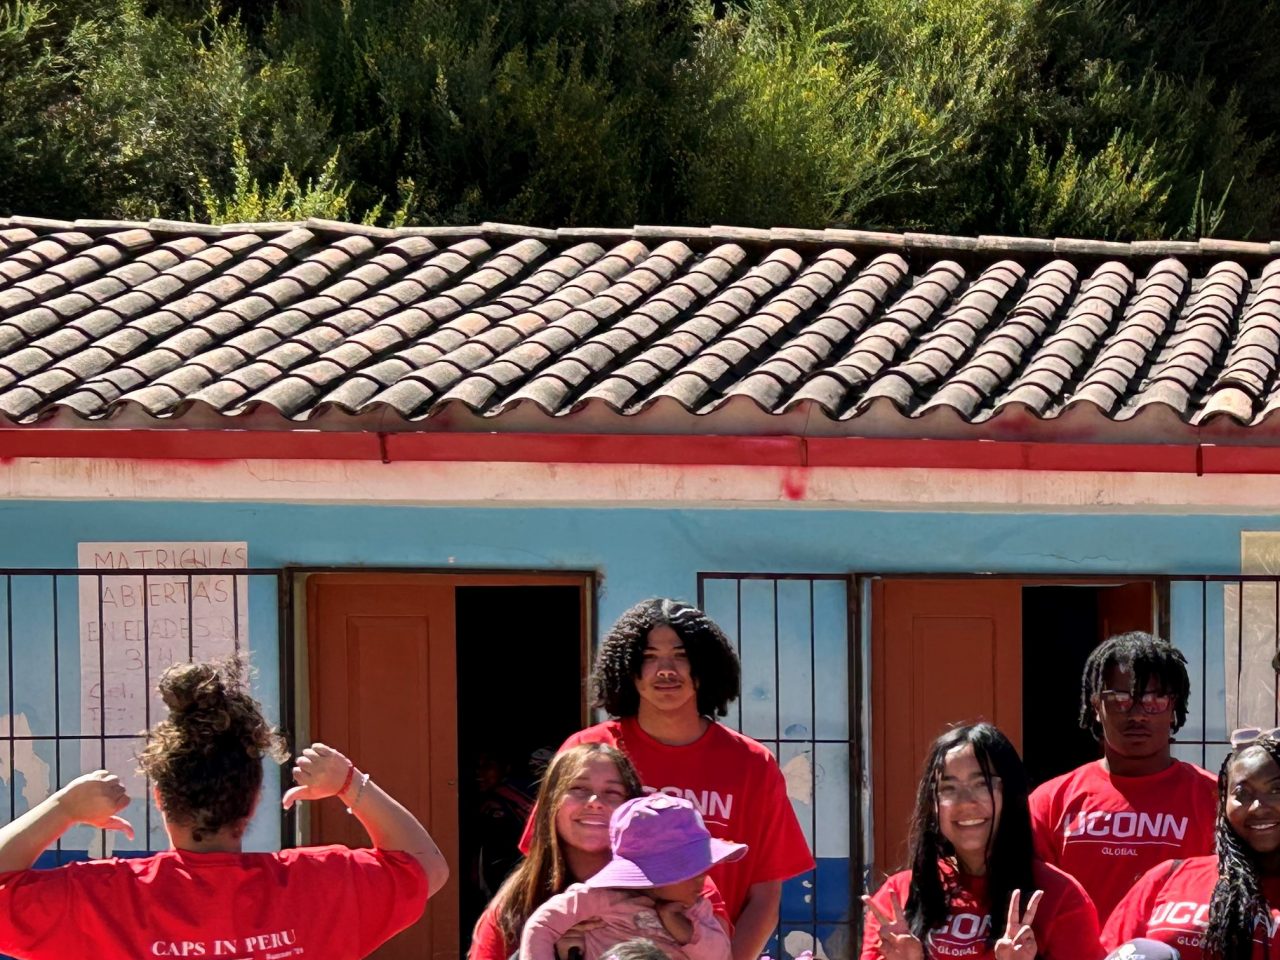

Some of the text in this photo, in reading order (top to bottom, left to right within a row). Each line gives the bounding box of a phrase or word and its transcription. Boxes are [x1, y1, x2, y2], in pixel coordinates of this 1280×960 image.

[102, 579, 229, 609] ABIERTAS
[1064, 810, 1188, 840] UCONN
[1101, 847, 1138, 856] GLOBAL
[152, 929, 296, 957] CAPS IN PERU
